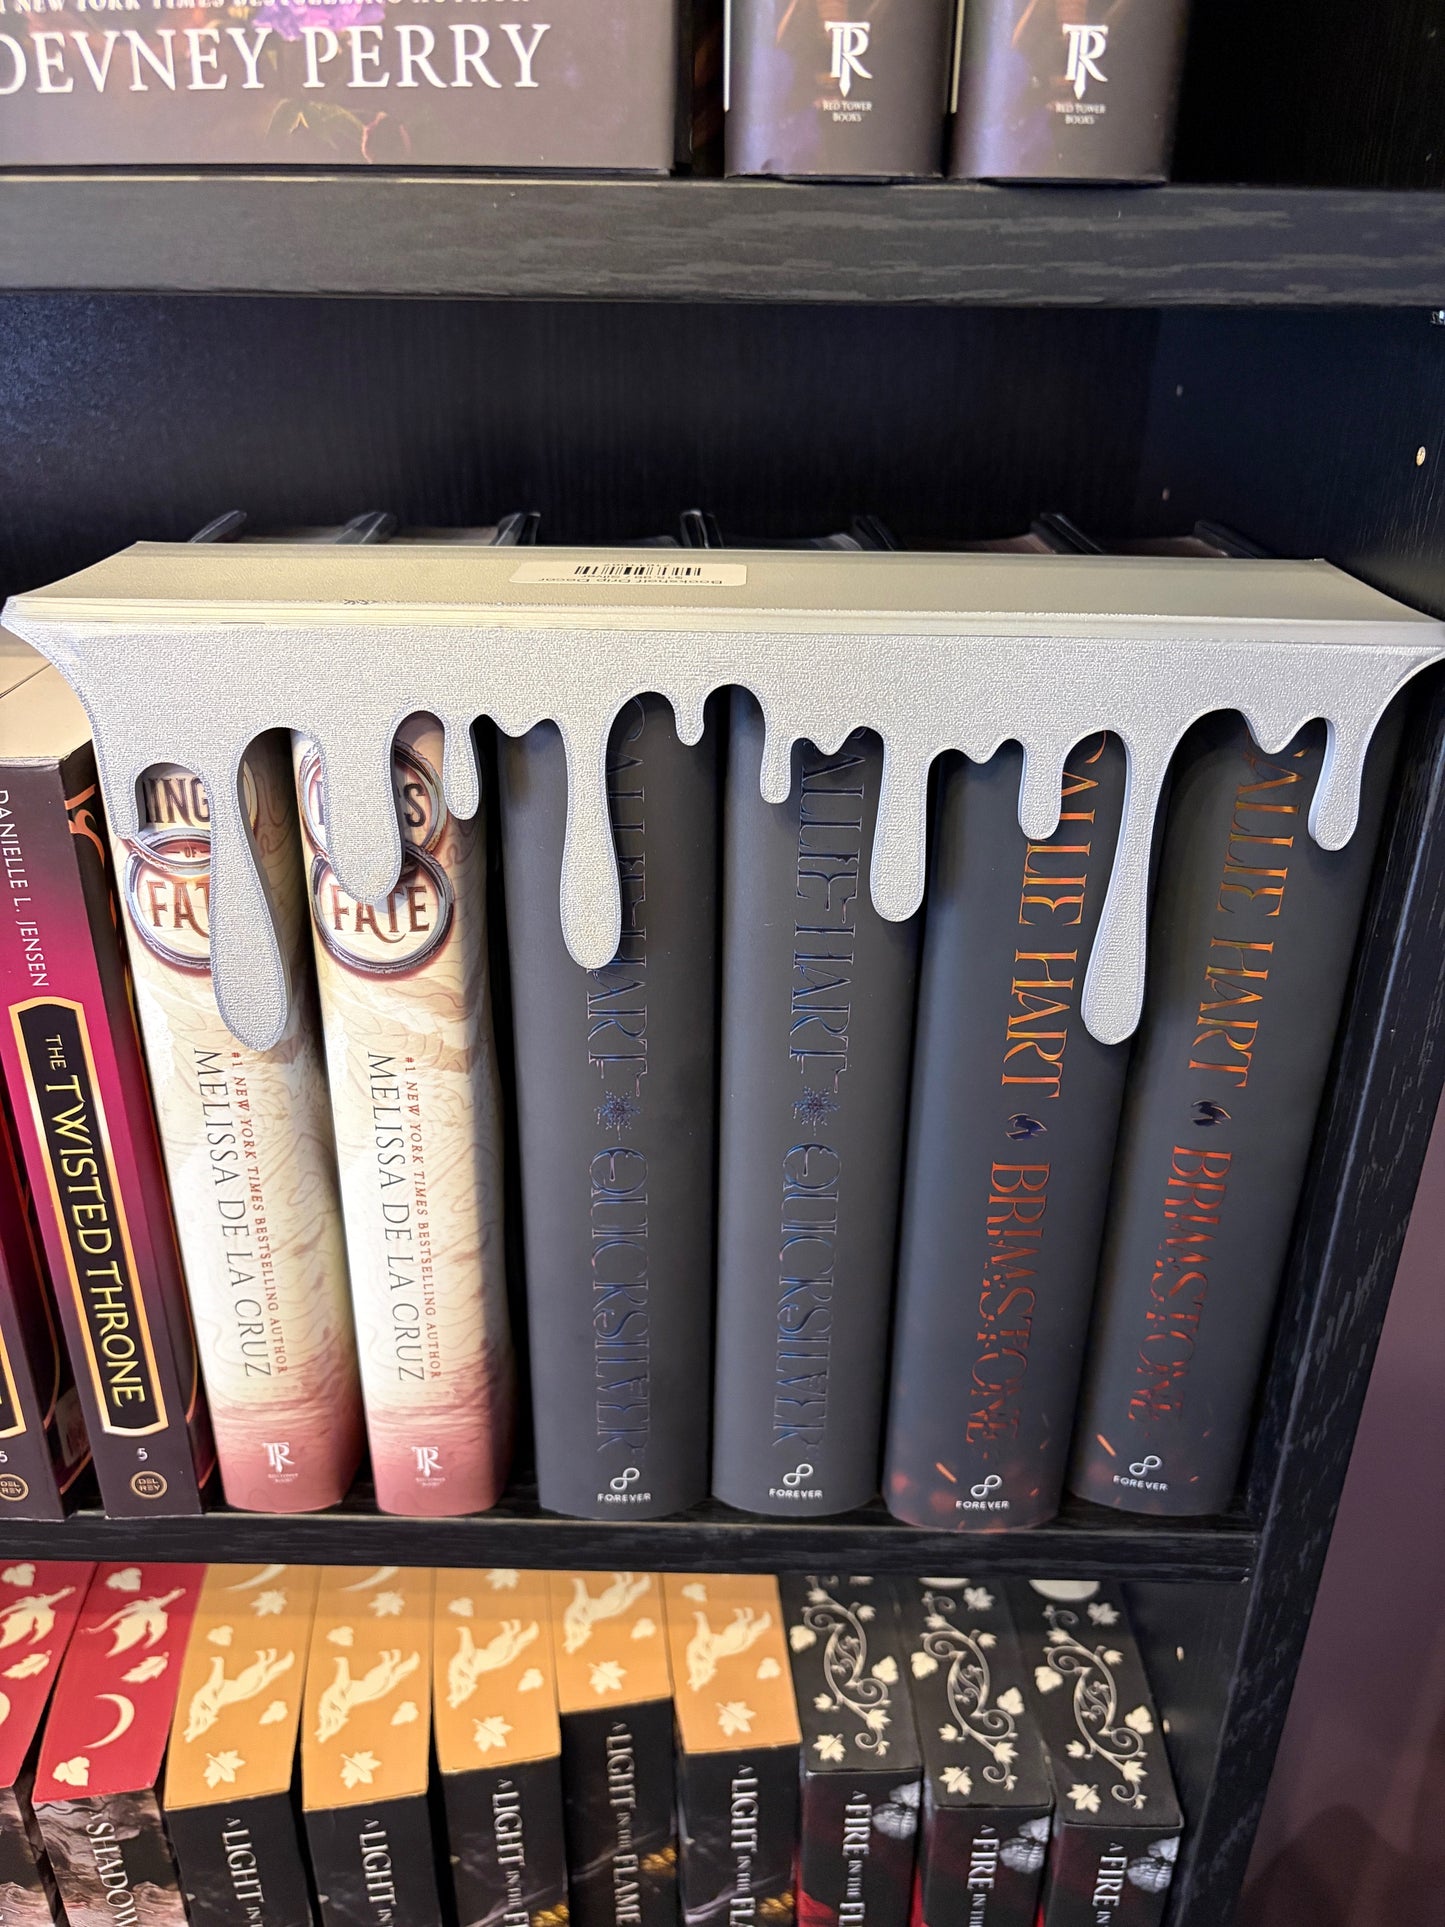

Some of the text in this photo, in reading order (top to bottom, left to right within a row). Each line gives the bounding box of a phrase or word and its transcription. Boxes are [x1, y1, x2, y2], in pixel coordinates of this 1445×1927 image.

[300, 23, 552, 89] PERRY
[184, 846, 198, 859] OF
[14, 897, 32, 913] L.
[1187, 748, 1308, 1089] ALLIE HART
[16, 920, 50, 987] JENSEN
[1001, 949, 1078, 1099] HART
[45, 1034, 146, 1408] THE TWISTED THRONE
[193, 1048, 272, 1377] MELISSA DE LA CRUZ
[231, 1051, 288, 1374] #1 NEW YORK TIMES BESTSELLING AUTHOR
[367, 1051, 425, 1381] MELISSA DE LA CRUZ
[404, 1057, 442, 1379] #1 NEW YORK TIMES BESTSELLING AUTHOR
[589, 1146, 650, 1451] QUICKSILVER
[772, 1142, 842, 1448] QUICKSILVER
[965, 1160, 1051, 1444] BRIMSTONE
[1127, 1145, 1232, 1422] BRIMSTONE
[137, 1448, 149, 1461] 5
[137, 1477, 159, 1486] DEL
[1113, 1474, 1169, 1492] FOREVER
[1, 1487, 23, 1495] REY
[138, 1484, 161, 1492] REY
[597, 1491, 652, 1502] FOREVER
[768, 1487, 823, 1499] FOREVER
[955, 1498, 1010, 1511] FOREVER
[497, 1779, 513, 1789] A
[606, 1734, 637, 1809] LIGHT
[225, 1817, 242, 1828] A
[492, 1791, 526, 1867] LIGHT
[730, 1778, 759, 1853] LIGHT
[841, 1804, 872, 1857] FIRE
[221, 1829, 265, 1903] LIGHT
[358, 1818, 398, 1923] A LIGHT IN
[612, 1853, 642, 1927] FLAME
[966, 1838, 1000, 1890] FIRE
[1092, 1855, 1128, 1907] FIRE
[245, 1906, 262, 1922] IN
[1096, 1911, 1111, 1923] IN
